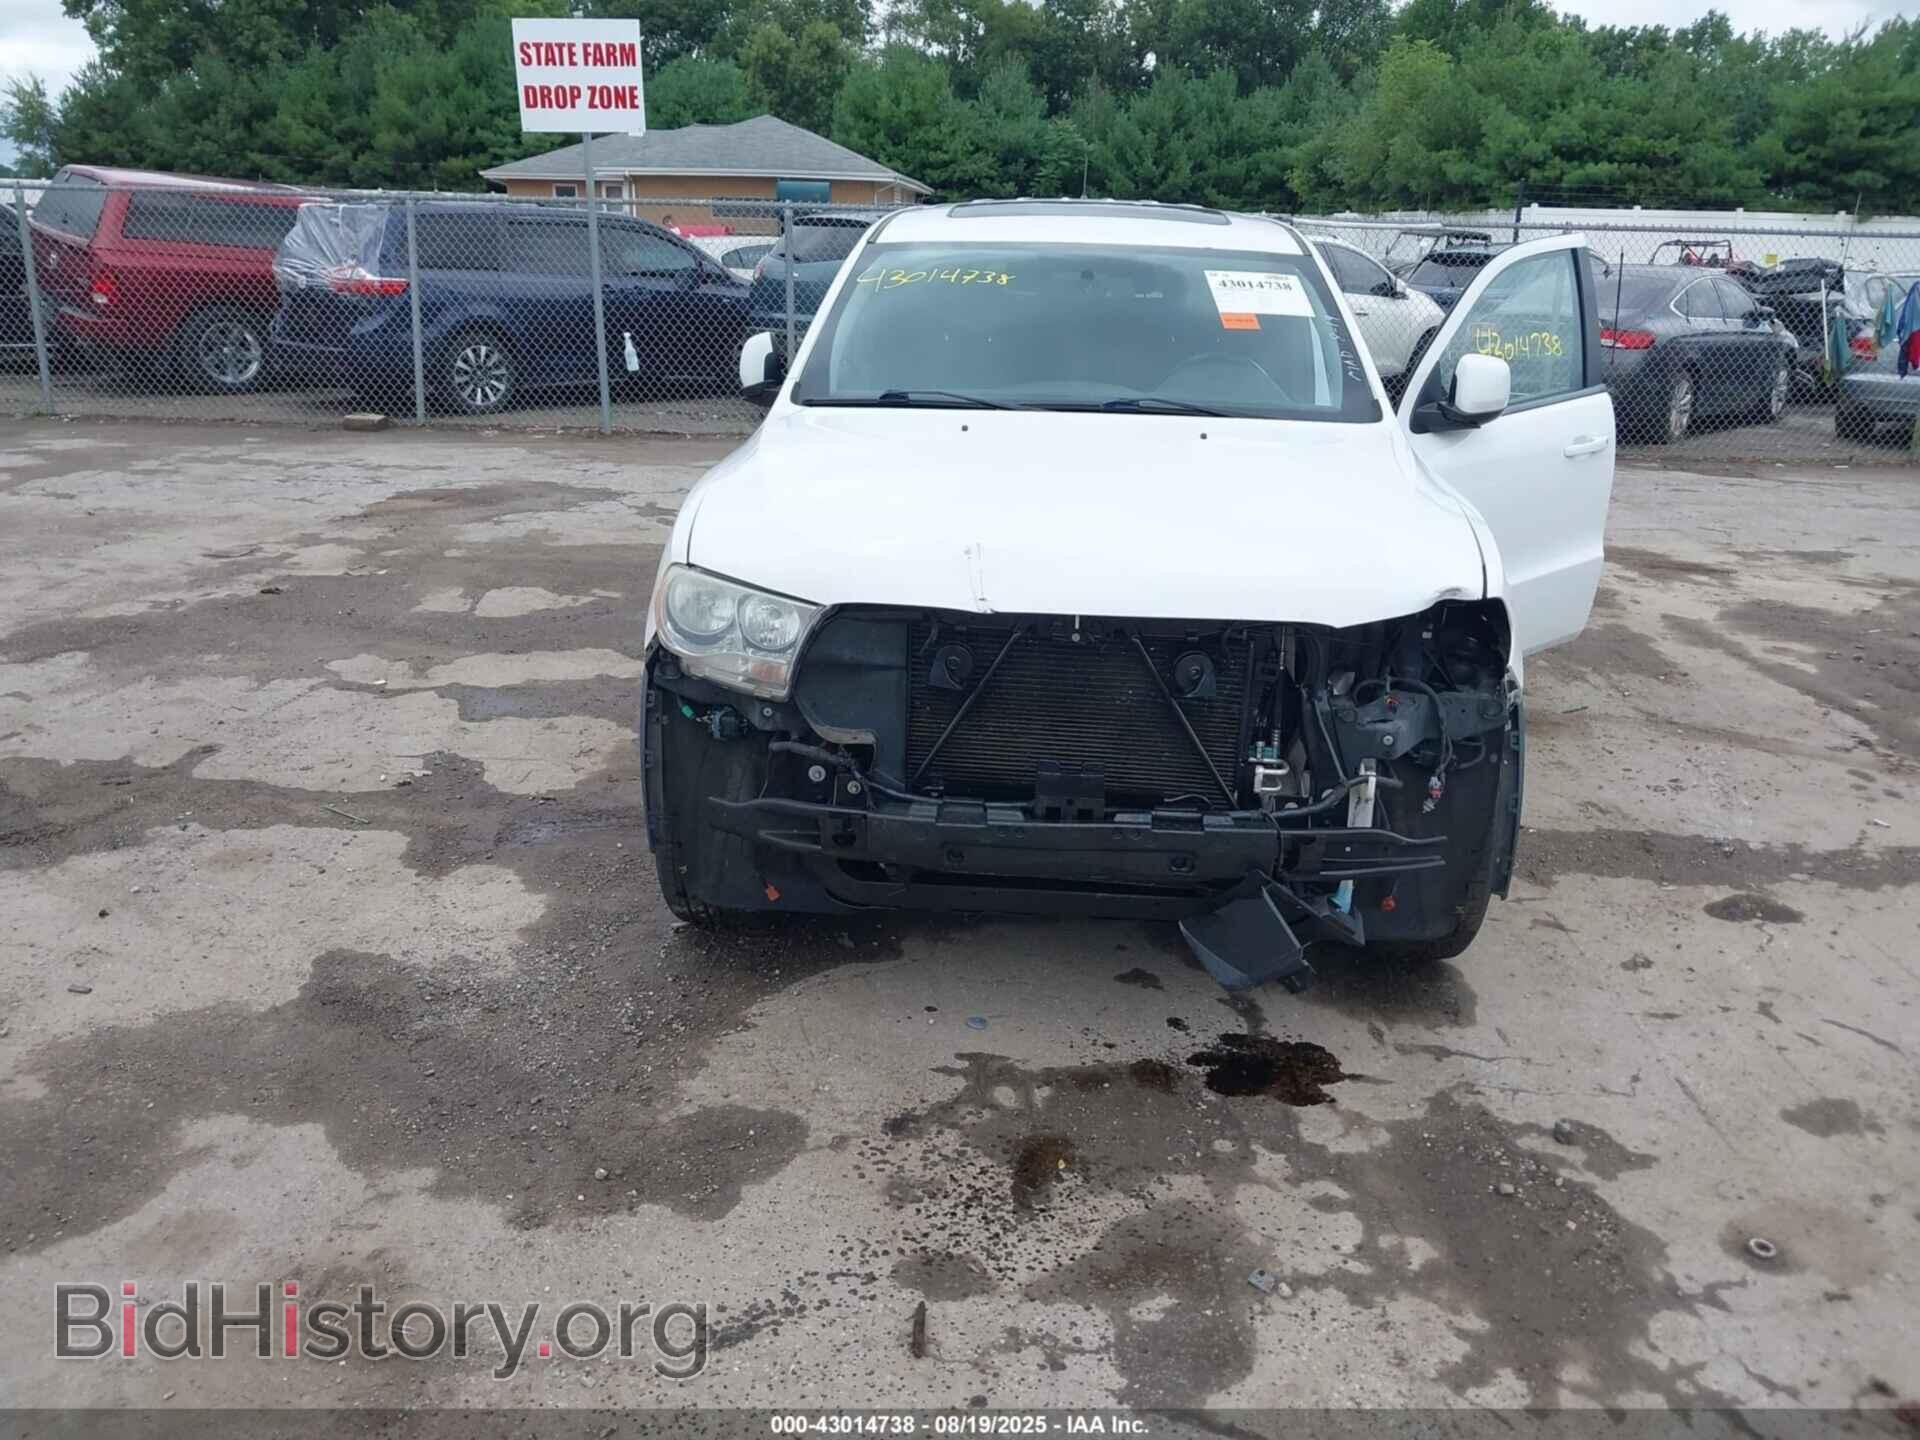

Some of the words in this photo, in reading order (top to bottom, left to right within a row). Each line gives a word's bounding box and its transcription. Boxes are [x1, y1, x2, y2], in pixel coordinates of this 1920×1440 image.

[520, 41, 578, 67] STATE
[582, 42, 636, 67] FARM
[524, 84, 581, 110] DROP
[587, 85, 639, 110] ZONE
[857, 267, 1016, 293] 43014738
[1217, 279, 1293, 292] 43014738
